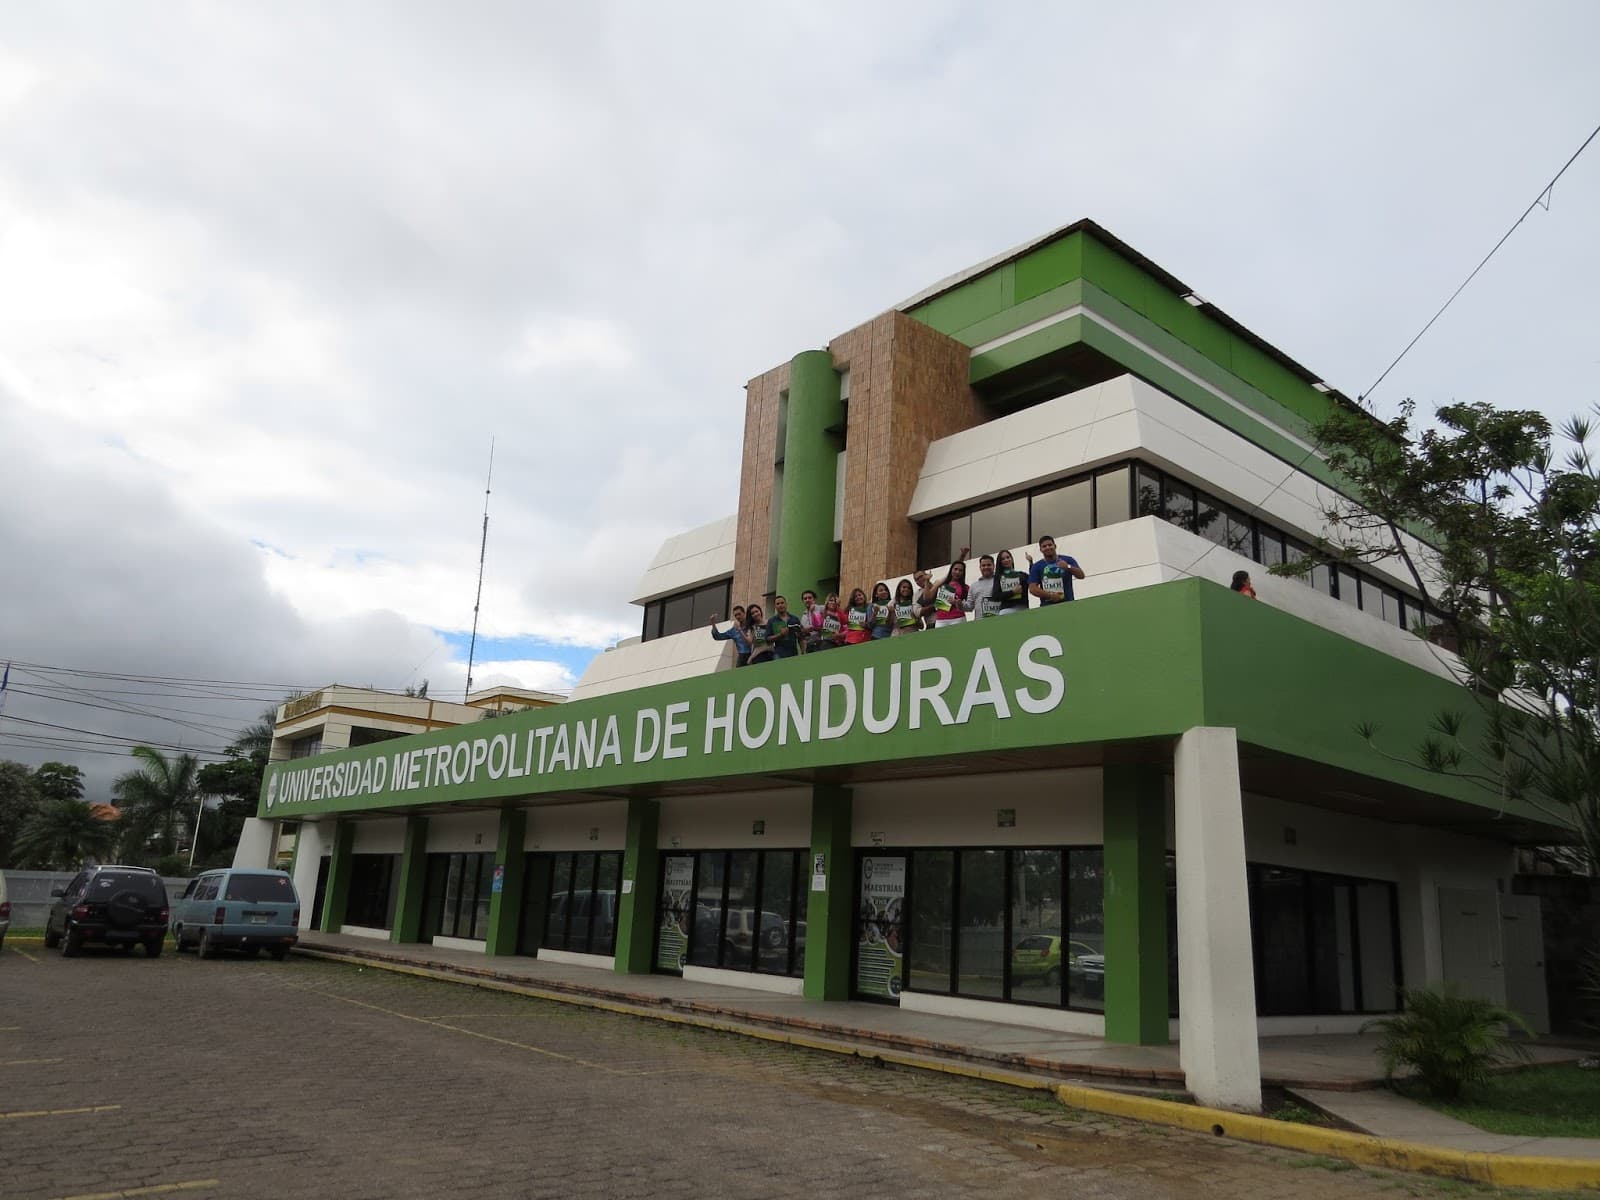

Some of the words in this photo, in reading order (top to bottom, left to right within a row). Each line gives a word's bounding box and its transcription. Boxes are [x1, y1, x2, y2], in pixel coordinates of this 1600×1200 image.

[279, 755, 388, 804] UNIVERSIDAD
[391, 714, 622, 792] METROPOLITANA
[634, 701, 690, 763] DE
[704, 634, 1065, 754] HONDURAS
